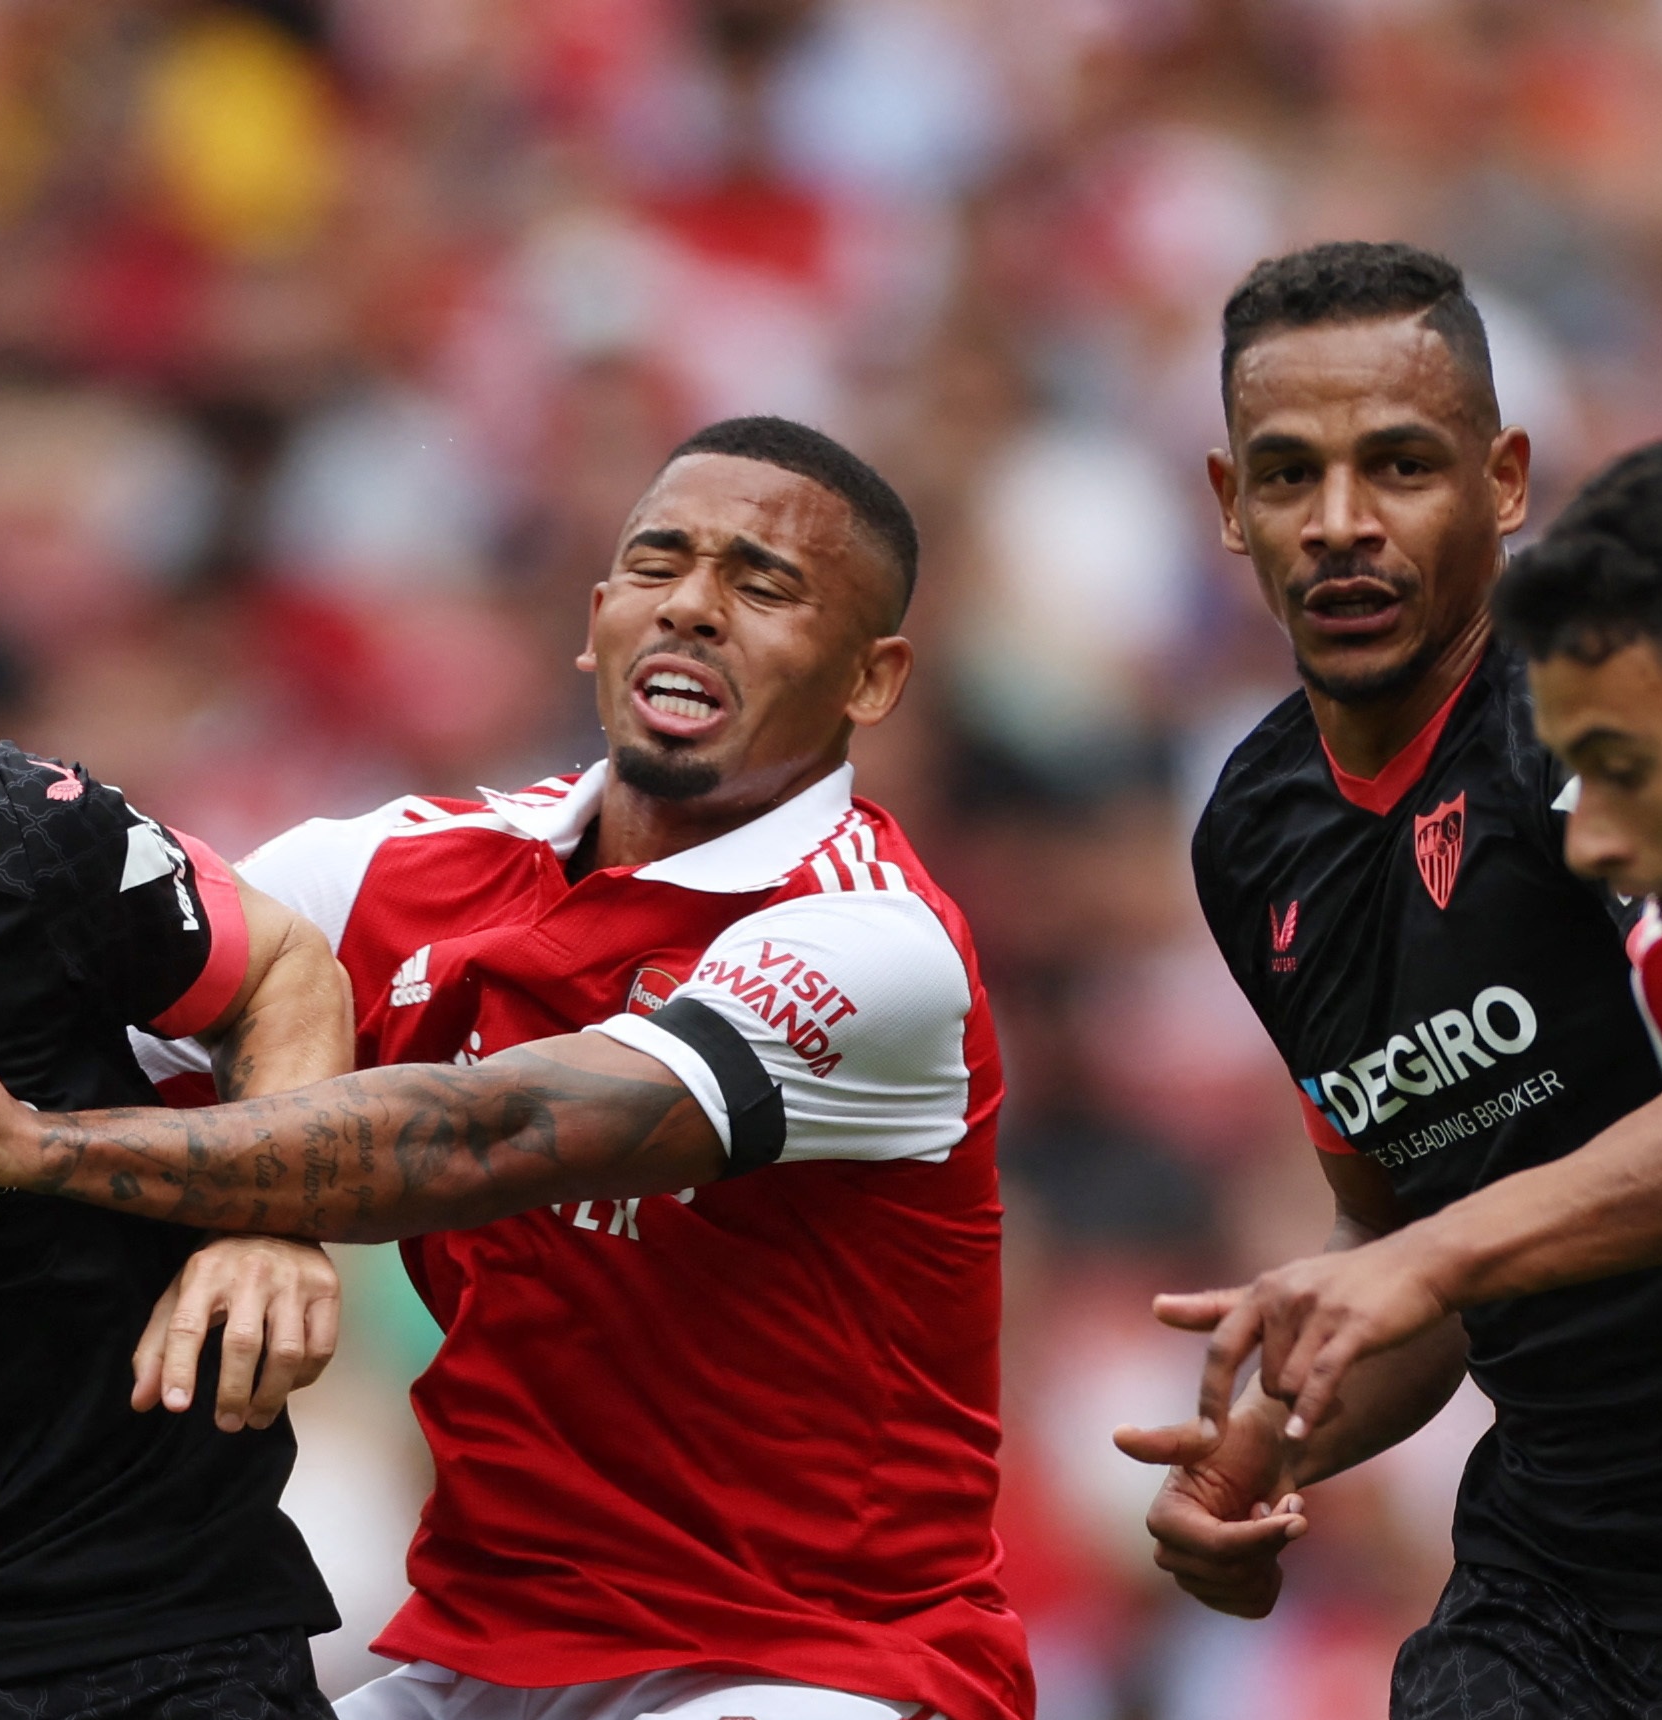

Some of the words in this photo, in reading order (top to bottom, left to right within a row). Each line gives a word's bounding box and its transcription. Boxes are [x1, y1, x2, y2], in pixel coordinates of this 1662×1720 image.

[631, 983, 667, 1011] Arsen
[758, 941, 857, 1028] VISIT
[1321, 985, 1537, 1135] DEGIRO
[1404, 1113, 1477, 1159] LEADING
[1474, 1069, 1565, 1129] BROKER
